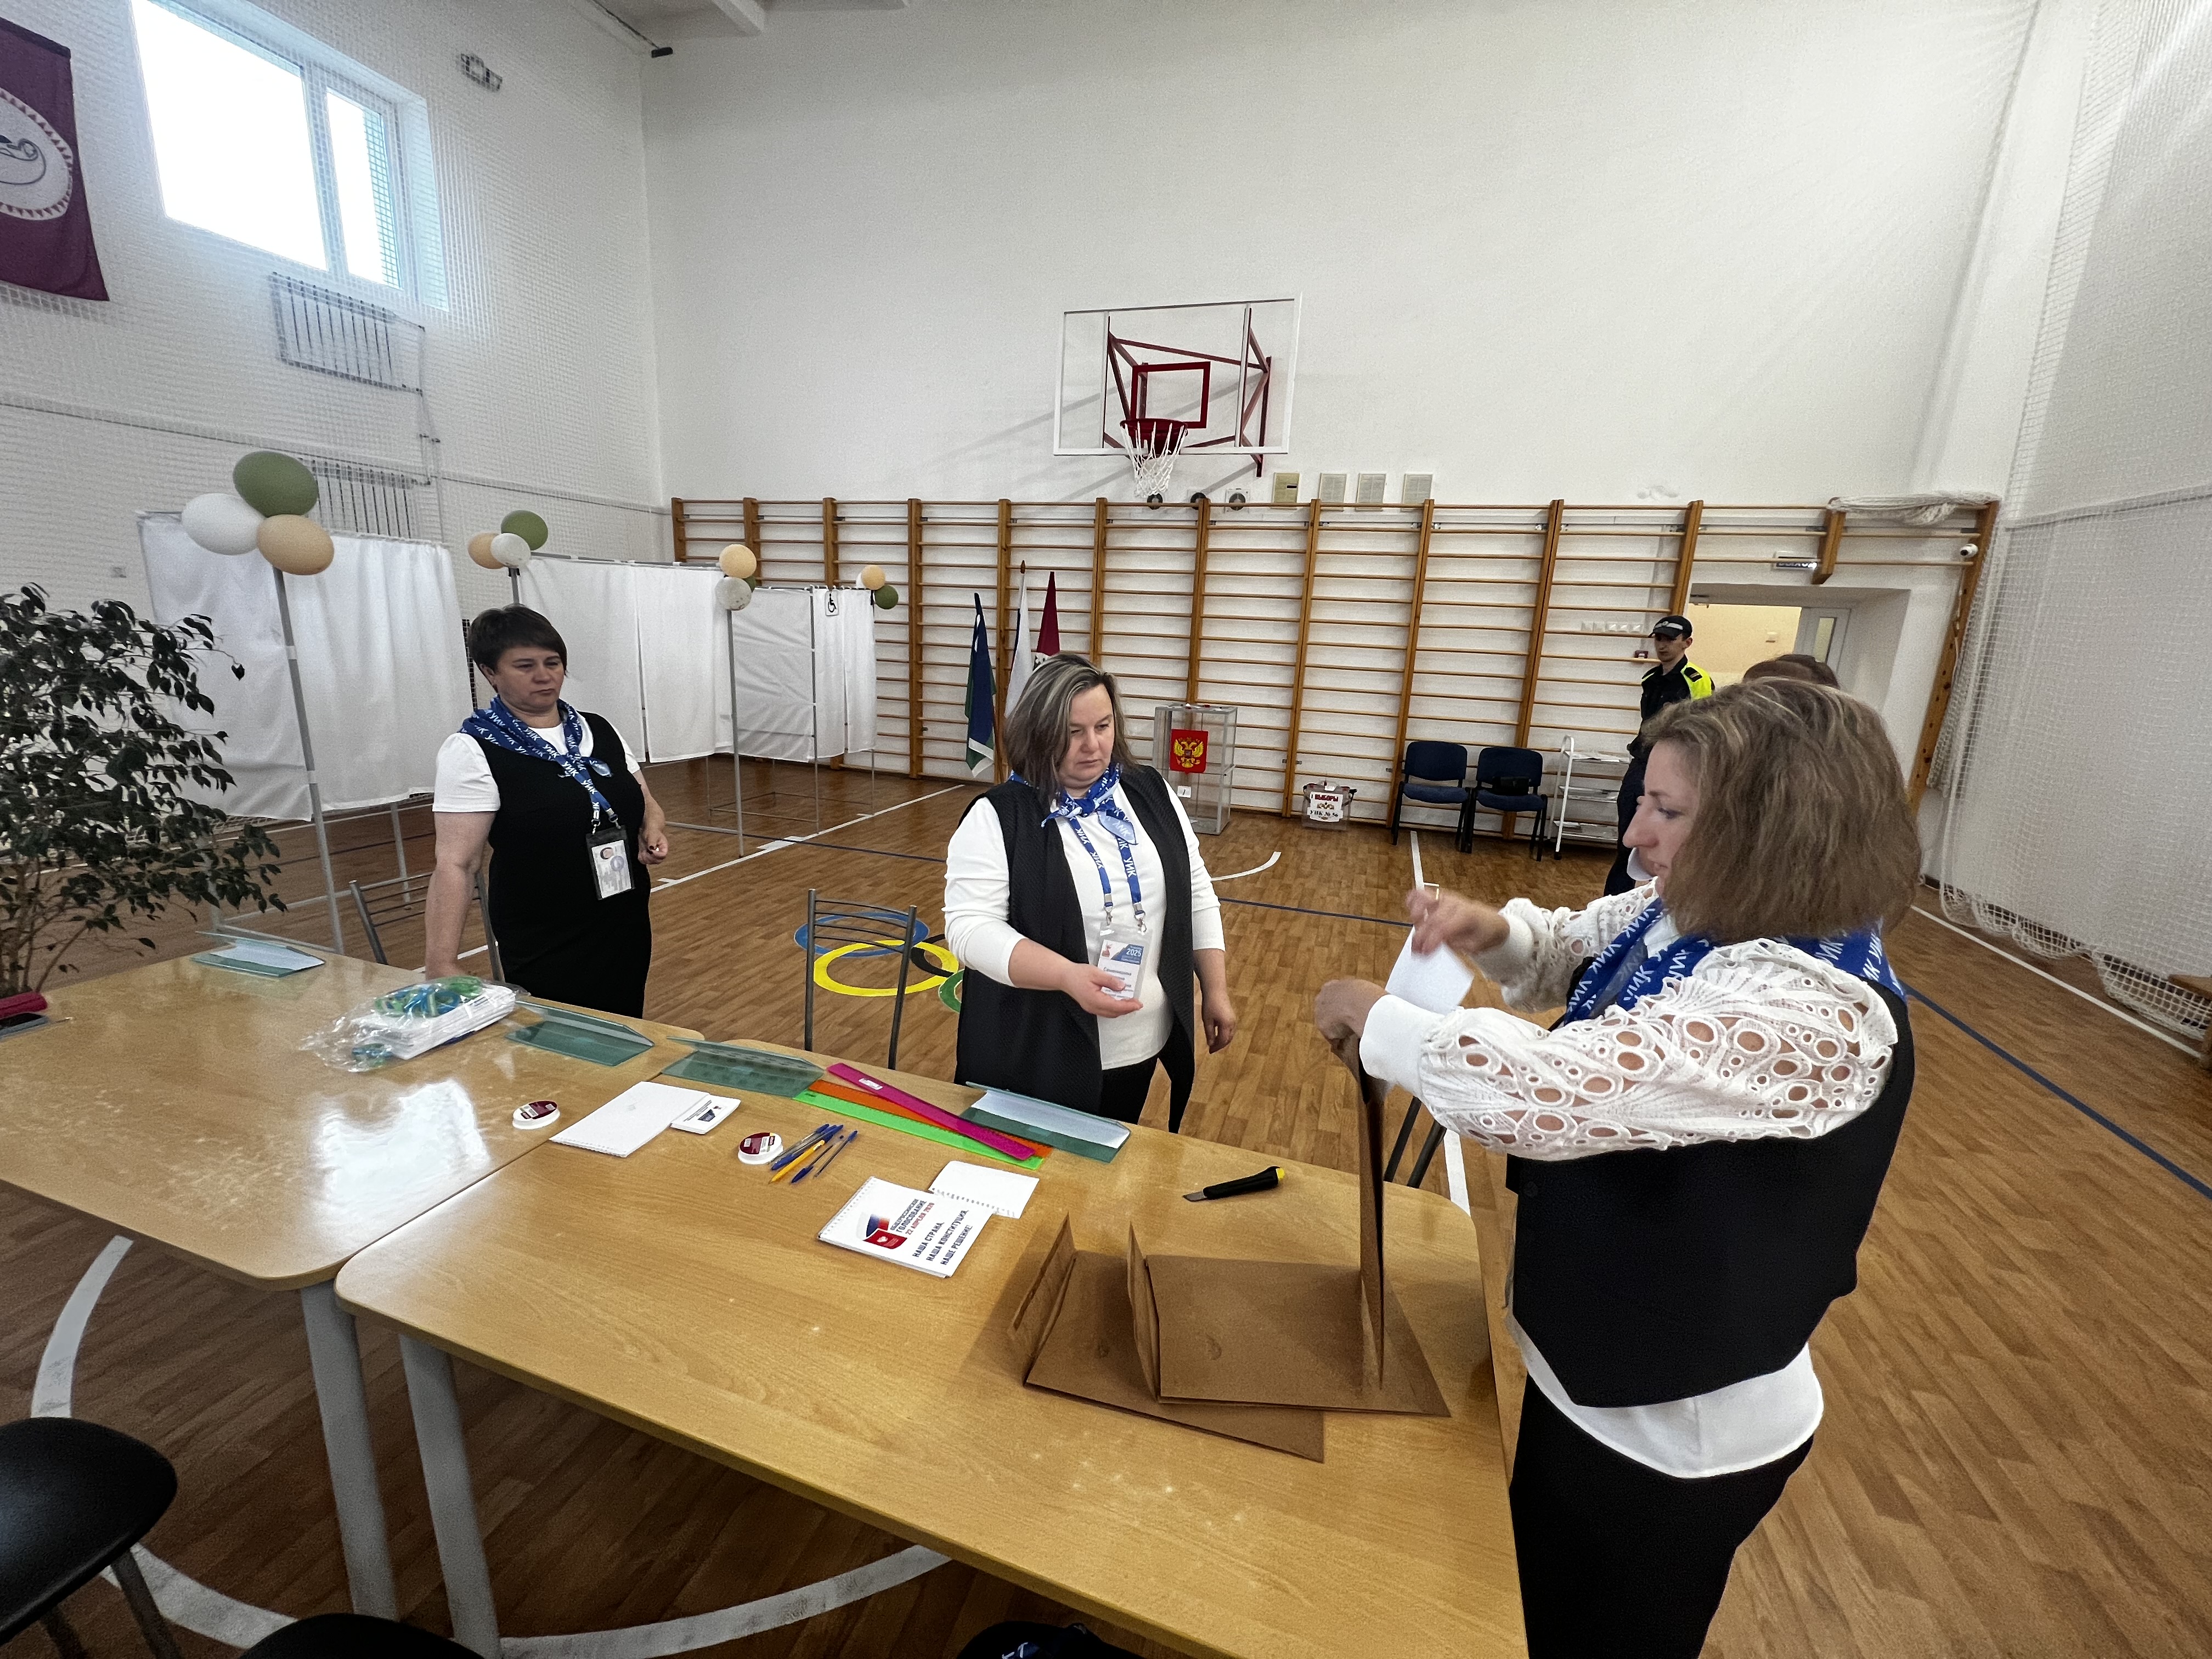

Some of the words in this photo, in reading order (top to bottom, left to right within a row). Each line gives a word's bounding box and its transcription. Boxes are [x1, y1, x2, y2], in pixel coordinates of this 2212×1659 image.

[542, 744, 560, 758] УИК
[562, 761, 579, 777] УИК
[582, 780, 598, 795] УИК
[1075, 828, 1090, 844] УИК
[1118, 838, 1129, 850] ИК
[1090, 851, 1105, 869] УИК
[1124, 857, 1137, 878] УИК
[1126, 948, 1142, 957] 2025
[896, 1200, 927, 1233] ГОЛОСОВАНИЕ
[912, 1242, 928, 1257] НАША
[926, 1246, 942, 1261] НАША
[940, 1250, 956, 1265] НАШЕ
